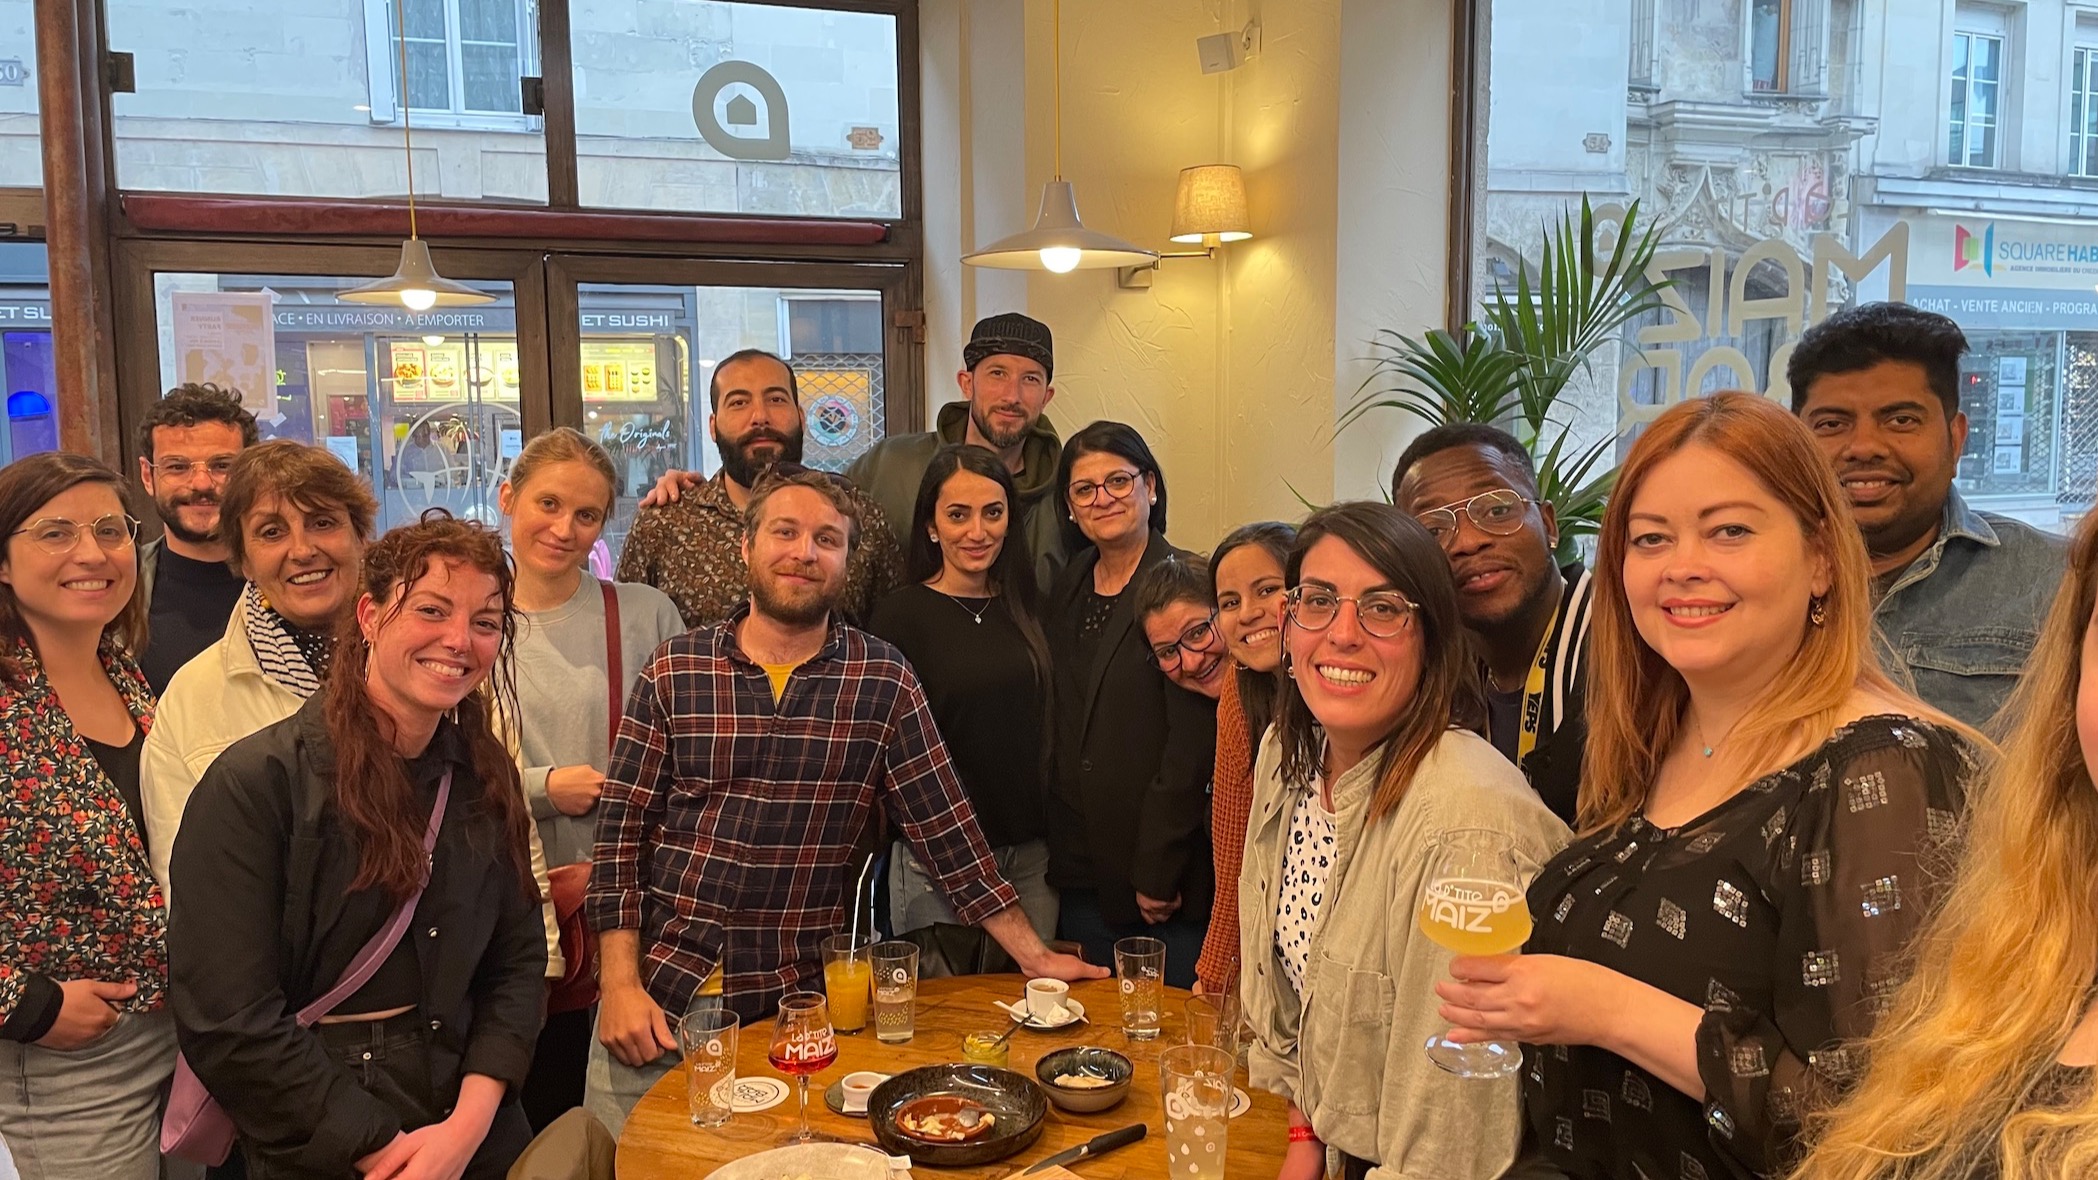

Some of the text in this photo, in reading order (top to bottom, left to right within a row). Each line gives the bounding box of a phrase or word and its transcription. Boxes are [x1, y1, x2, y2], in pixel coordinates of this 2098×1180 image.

[1913, 298, 1951, 312] ACHAT
[1961, 300, 1998, 313] VENTE
[2001, 301, 2043, 314] ANCIEN
[273, 313, 295, 325] ACE
[306, 313, 322, 325] EN
[328, 313, 394, 325] LIVRAISON
[418, 314, 484, 326] EMPORTER
[582, 315, 669, 327] ET SUSHI
[1421, 885, 1493, 933] MAIZ
[785, 1035, 835, 1060] MAIZ
